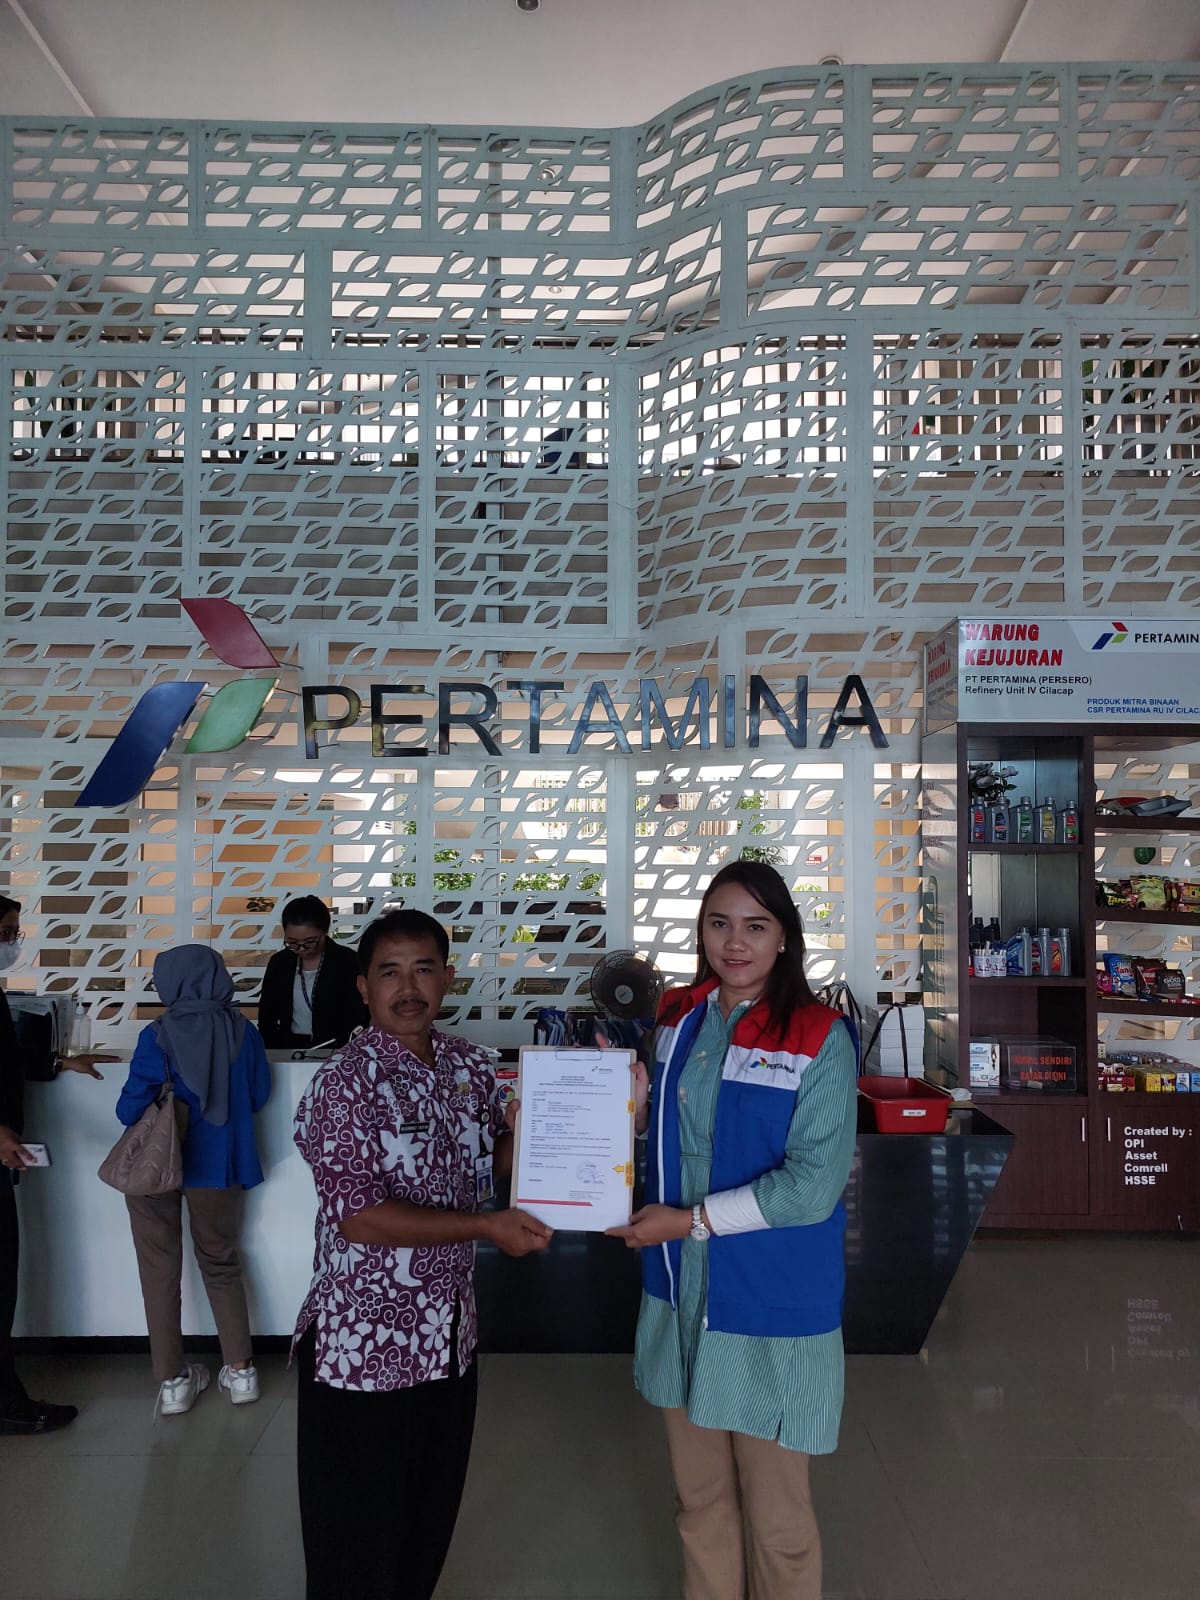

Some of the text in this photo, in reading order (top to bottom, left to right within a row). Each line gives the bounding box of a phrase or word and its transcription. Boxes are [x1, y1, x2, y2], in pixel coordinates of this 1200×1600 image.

[965, 624, 1040, 641] WARUNG
[1134, 633, 1199, 644] PERTAMIN
[964, 648, 1063, 667] KEJUJURAN
[980, 676, 1036, 684] PERTAMINA
[1039, 675, 1093, 685] (PERSERO)
[965, 686, 1074, 696] Refinery Unit IV Cilacap
[1105, 706, 1151, 714] PERTAMINA
[301, 674, 890, 760] PERTAMINA
[1039, 1056, 1073, 1065] SENDIRI
[1124, 1126, 1169, 1136] Created
[1172, 1126, 1185, 1138] by
[1124, 1138, 1145, 1149] OPI
[1125, 1150, 1158, 1160] Asset
[1124, 1163, 1168, 1173] Comrell
[1124, 1175, 1156, 1186] HSSE
